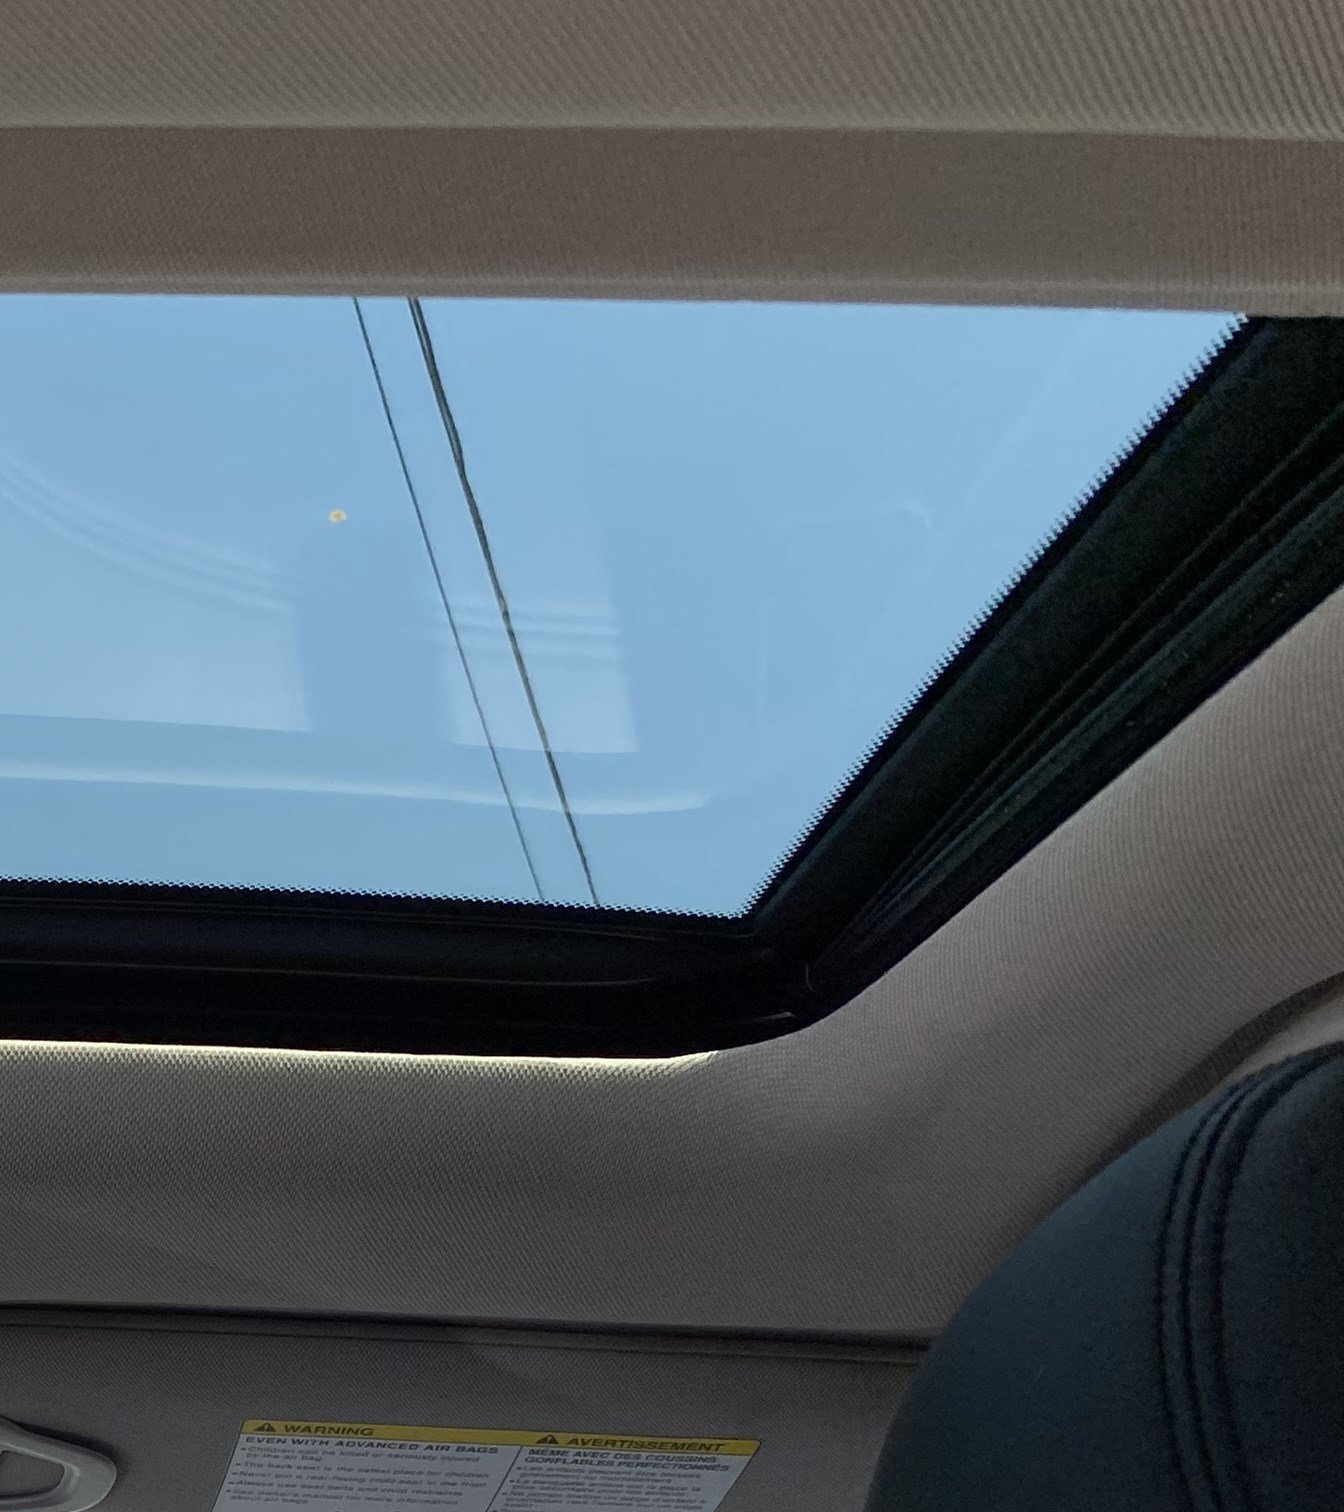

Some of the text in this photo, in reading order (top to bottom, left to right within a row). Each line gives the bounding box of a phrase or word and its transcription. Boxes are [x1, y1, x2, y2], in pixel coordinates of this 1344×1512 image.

[283, 1424, 375, 1436] WARNING
[245, 1436, 499, 1454] EVEN WITH ADVANCED AIR BAGS
[567, 1437, 725, 1452] AVERTISSEMENT
[524, 1456, 615, 1467] GONFLABLES
[572, 1450, 611, 1459] AVEC
[613, 1452, 641, 1460] DES
[645, 1454, 717, 1463] COUSSINS
